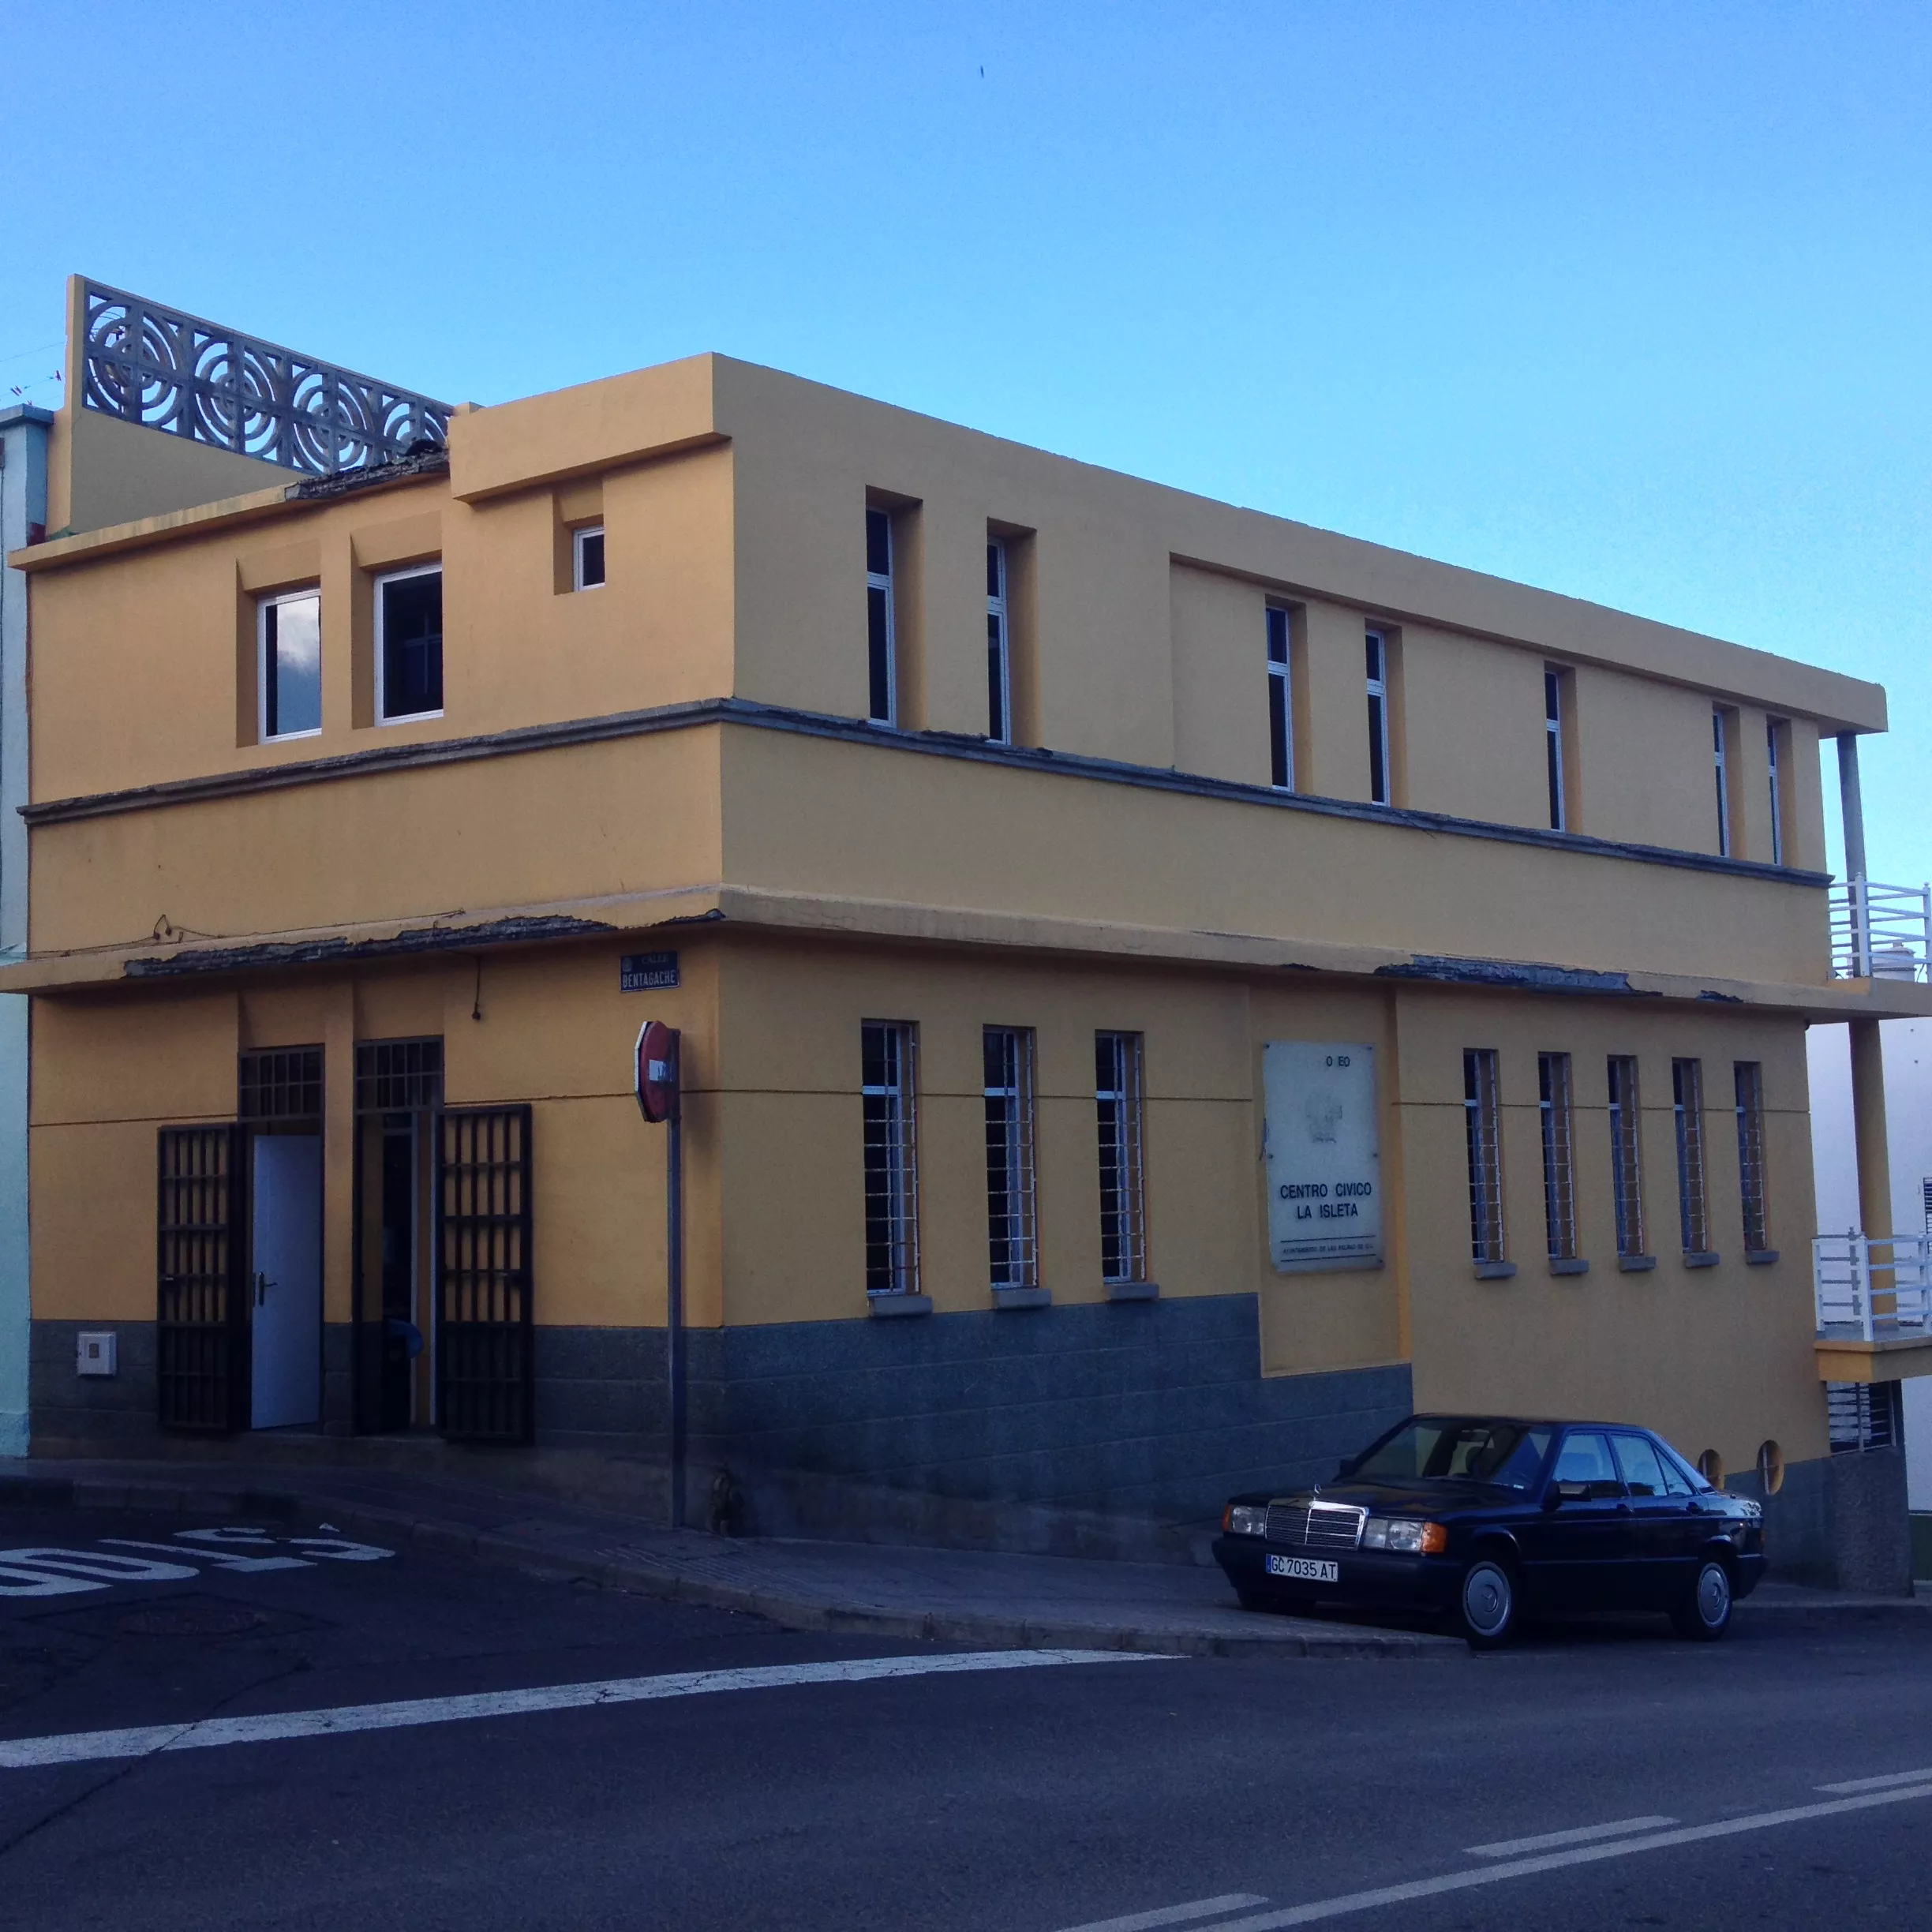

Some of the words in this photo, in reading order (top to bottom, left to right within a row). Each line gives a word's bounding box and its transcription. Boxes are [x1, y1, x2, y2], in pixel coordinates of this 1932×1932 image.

[623, 970, 676, 988] BENTAGACHE
[1280, 1184, 1328, 1199] CENTRO
[1335, 1182, 1372, 1196] CIVICO
[1297, 1205, 1312, 1219] LA
[1320, 1203, 1358, 1218] ISLETA
[1271, 1557, 1285, 1573] GC
[1286, 1559, 1317, 1577] 7035
[1320, 1563, 1336, 1579] AT
